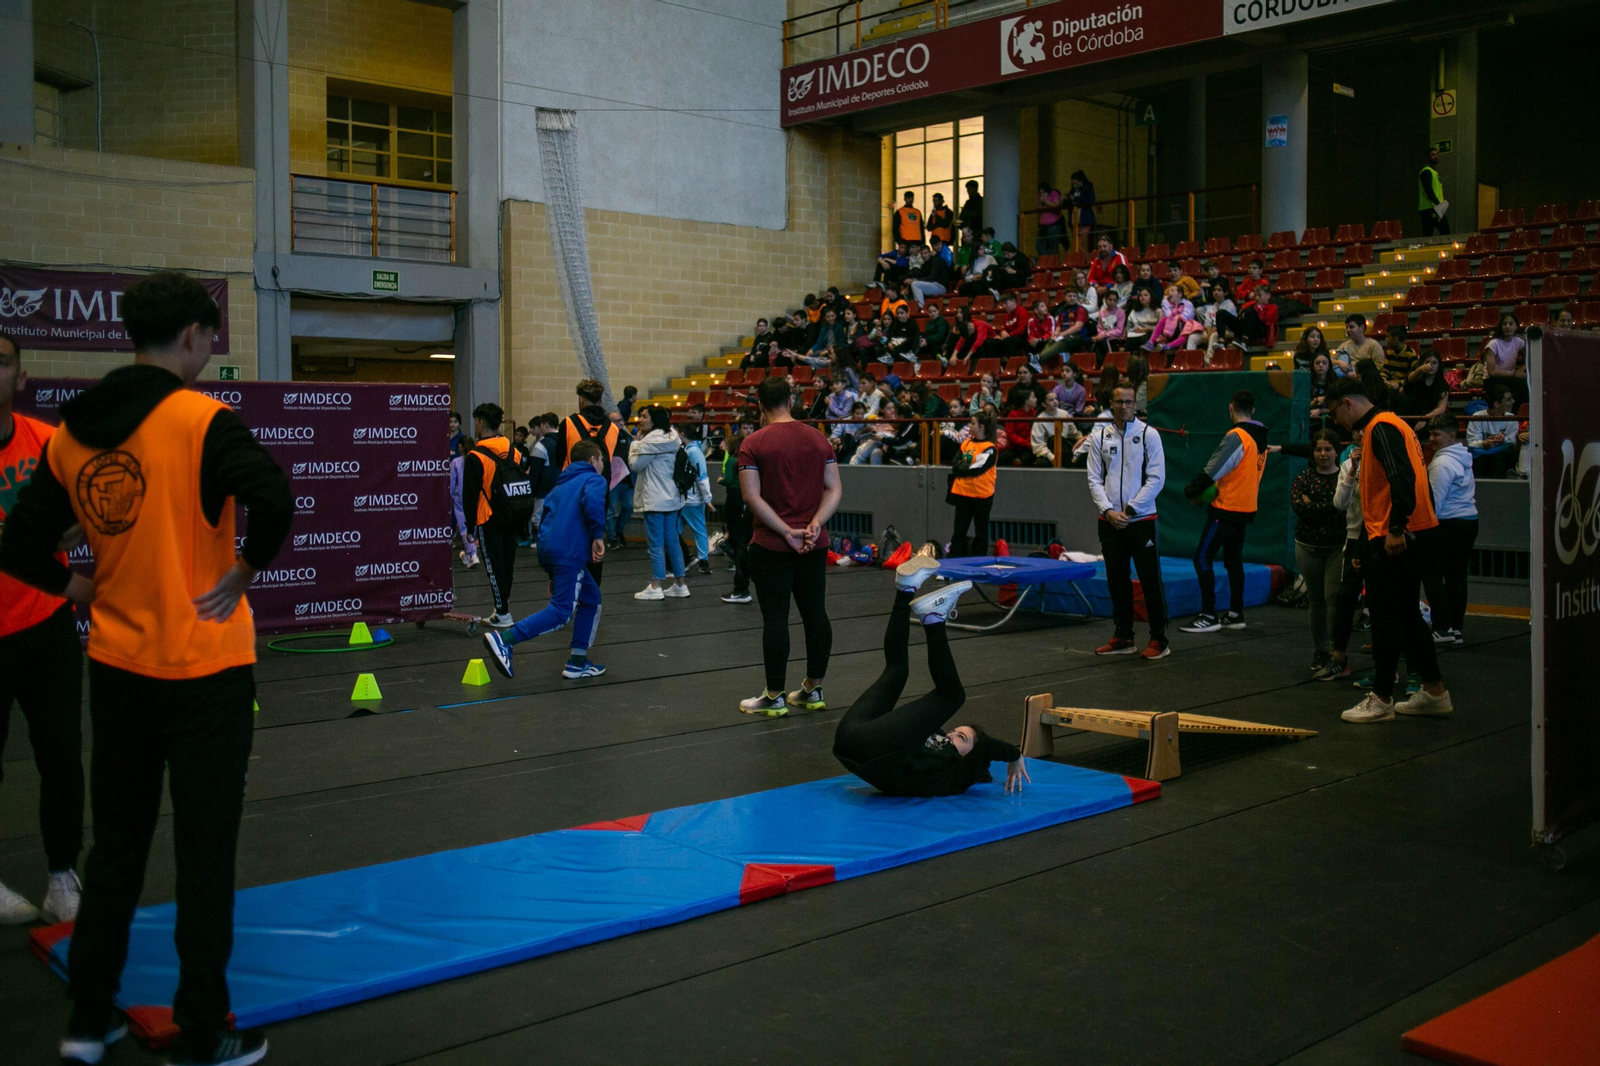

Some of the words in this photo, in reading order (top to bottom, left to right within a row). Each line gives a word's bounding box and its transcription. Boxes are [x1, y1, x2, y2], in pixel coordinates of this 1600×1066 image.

[1052, 4, 1143, 38] Diputación
[1052, 40, 1072, 58] de
[1076, 26, 1144, 53] Córdoba
[818, 42, 930, 95] IMDECO
[788, 104, 816, 116] Instituto
[816, 96, 850, 111] Municipal
[850, 94, 861, 103] de
[861, 88, 895, 101] Deportes
[896, 80, 929, 94] Córdoba
[1143, 104, 1156, 122] A
[0, 324, 48, 337] Instituto
[51, 328, 105, 340] Municipal
[108, 330, 122, 339] de
[300, 392, 352, 404] IMDECO
[404, 394, 451, 406] IMDECO
[260, 427, 314, 439] IMDECO
[368, 427, 418, 438] IMDECO
[308, 461, 360, 473] IMDECO
[412, 460, 450, 471] IMDEC
[503, 480, 531, 497] VANS
[369, 493, 418, 506] IMDECO
[310, 531, 361, 544] IMDECO
[413, 526, 452, 539] IMDEC
[263, 567, 316, 582] IMDECO
[370, 561, 419, 575] IMDECO
[415, 591, 454, 605] IMDEC
[1556, 578, 1600, 620] Instit
[311, 598, 362, 614] IMDECO
